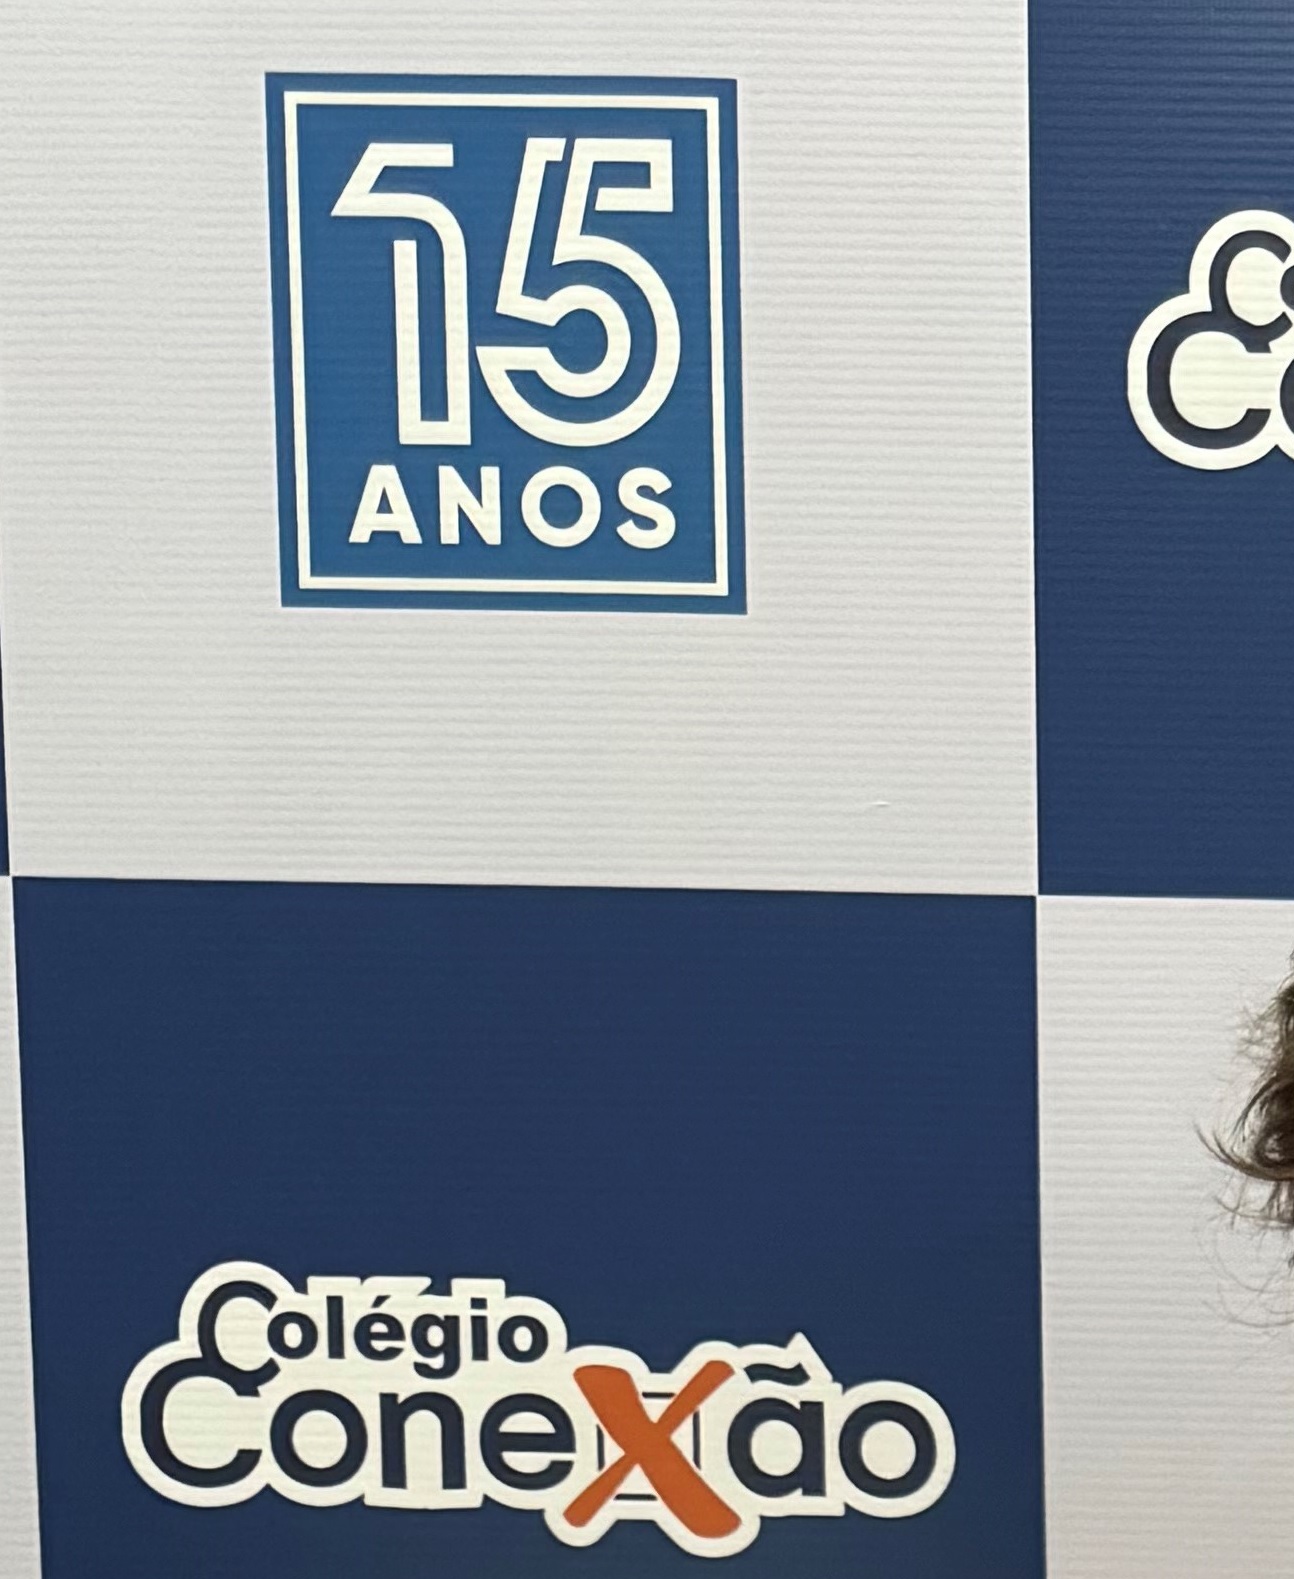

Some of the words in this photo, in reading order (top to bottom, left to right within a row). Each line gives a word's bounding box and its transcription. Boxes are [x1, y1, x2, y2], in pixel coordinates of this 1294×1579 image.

[331, 138, 681, 447] 15
[348, 464, 677, 550] ANOS
[198, 1280, 549, 1386] Colégio
